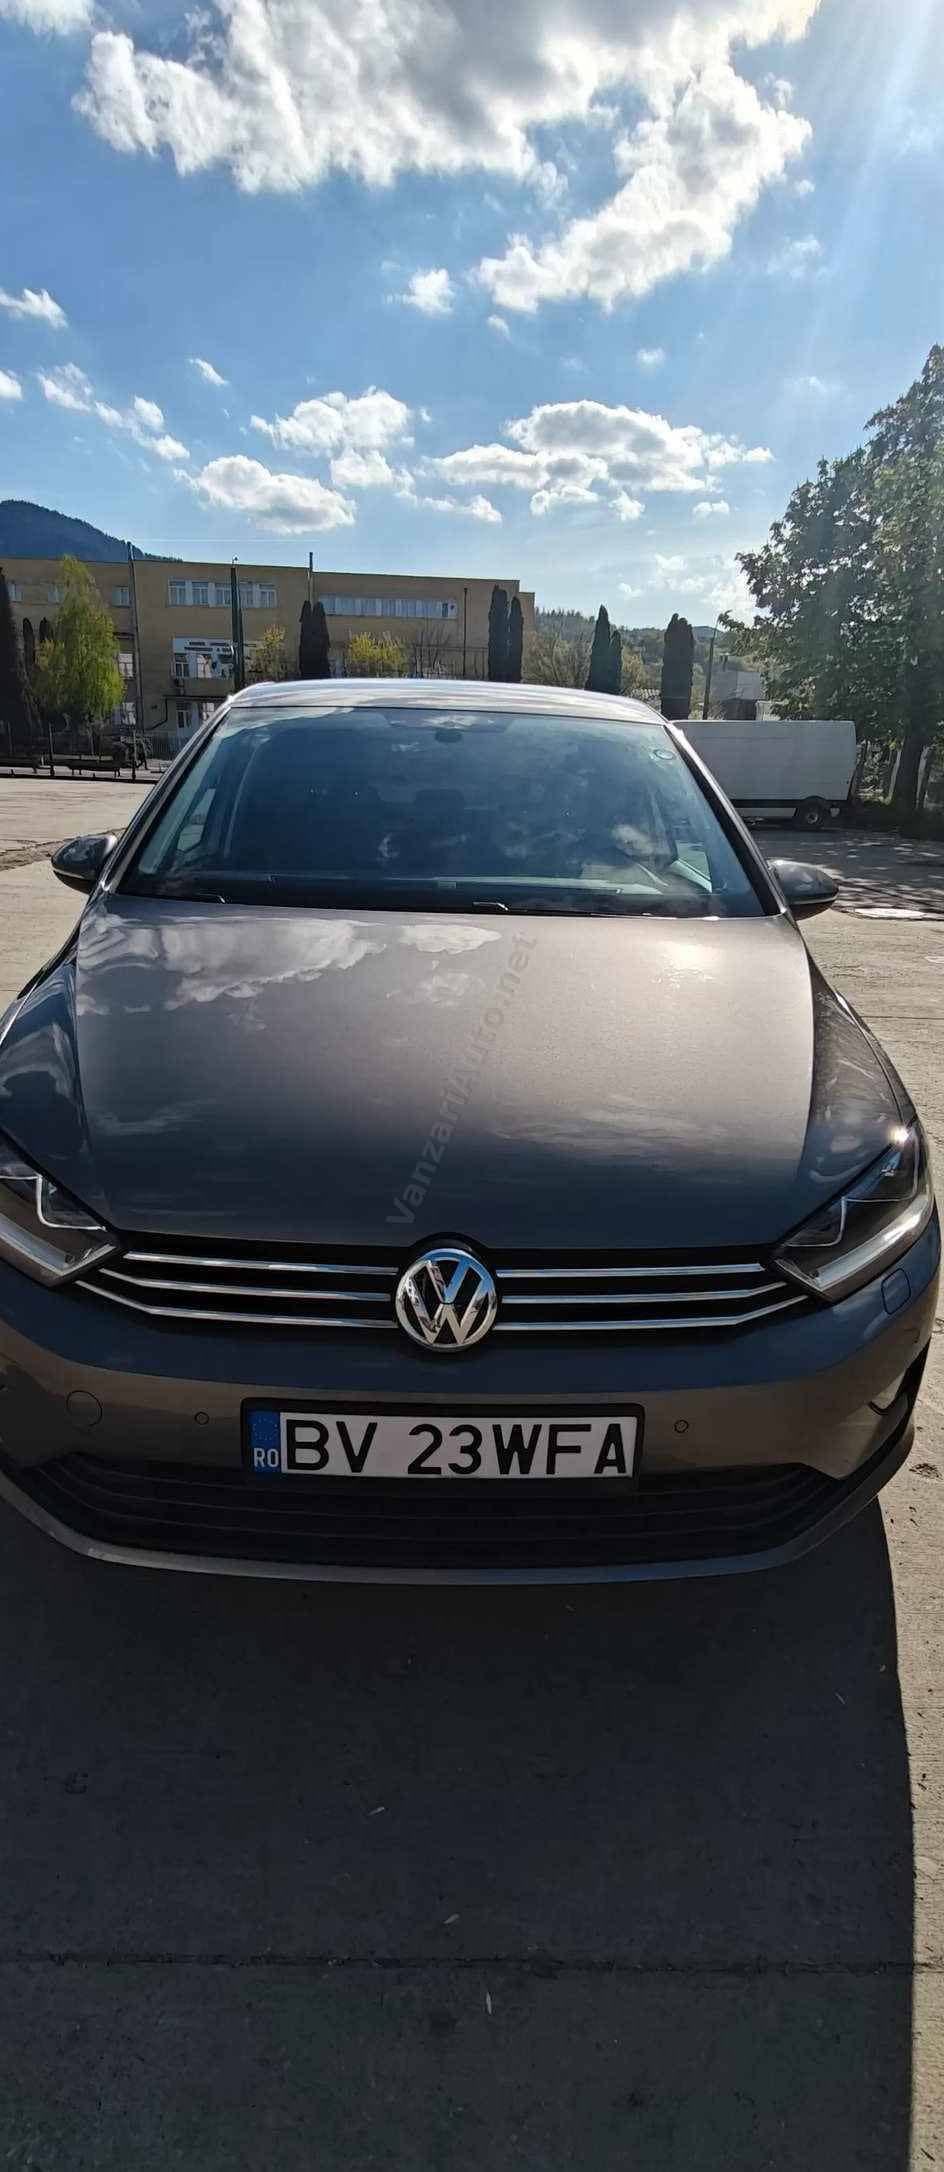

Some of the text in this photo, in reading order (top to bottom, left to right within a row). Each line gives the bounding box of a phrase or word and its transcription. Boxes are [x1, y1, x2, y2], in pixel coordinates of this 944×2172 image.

[396, 1248, 498, 1352] VW
[253, 1447, 280, 1469] RO
[285, 1418, 379, 1474] BV
